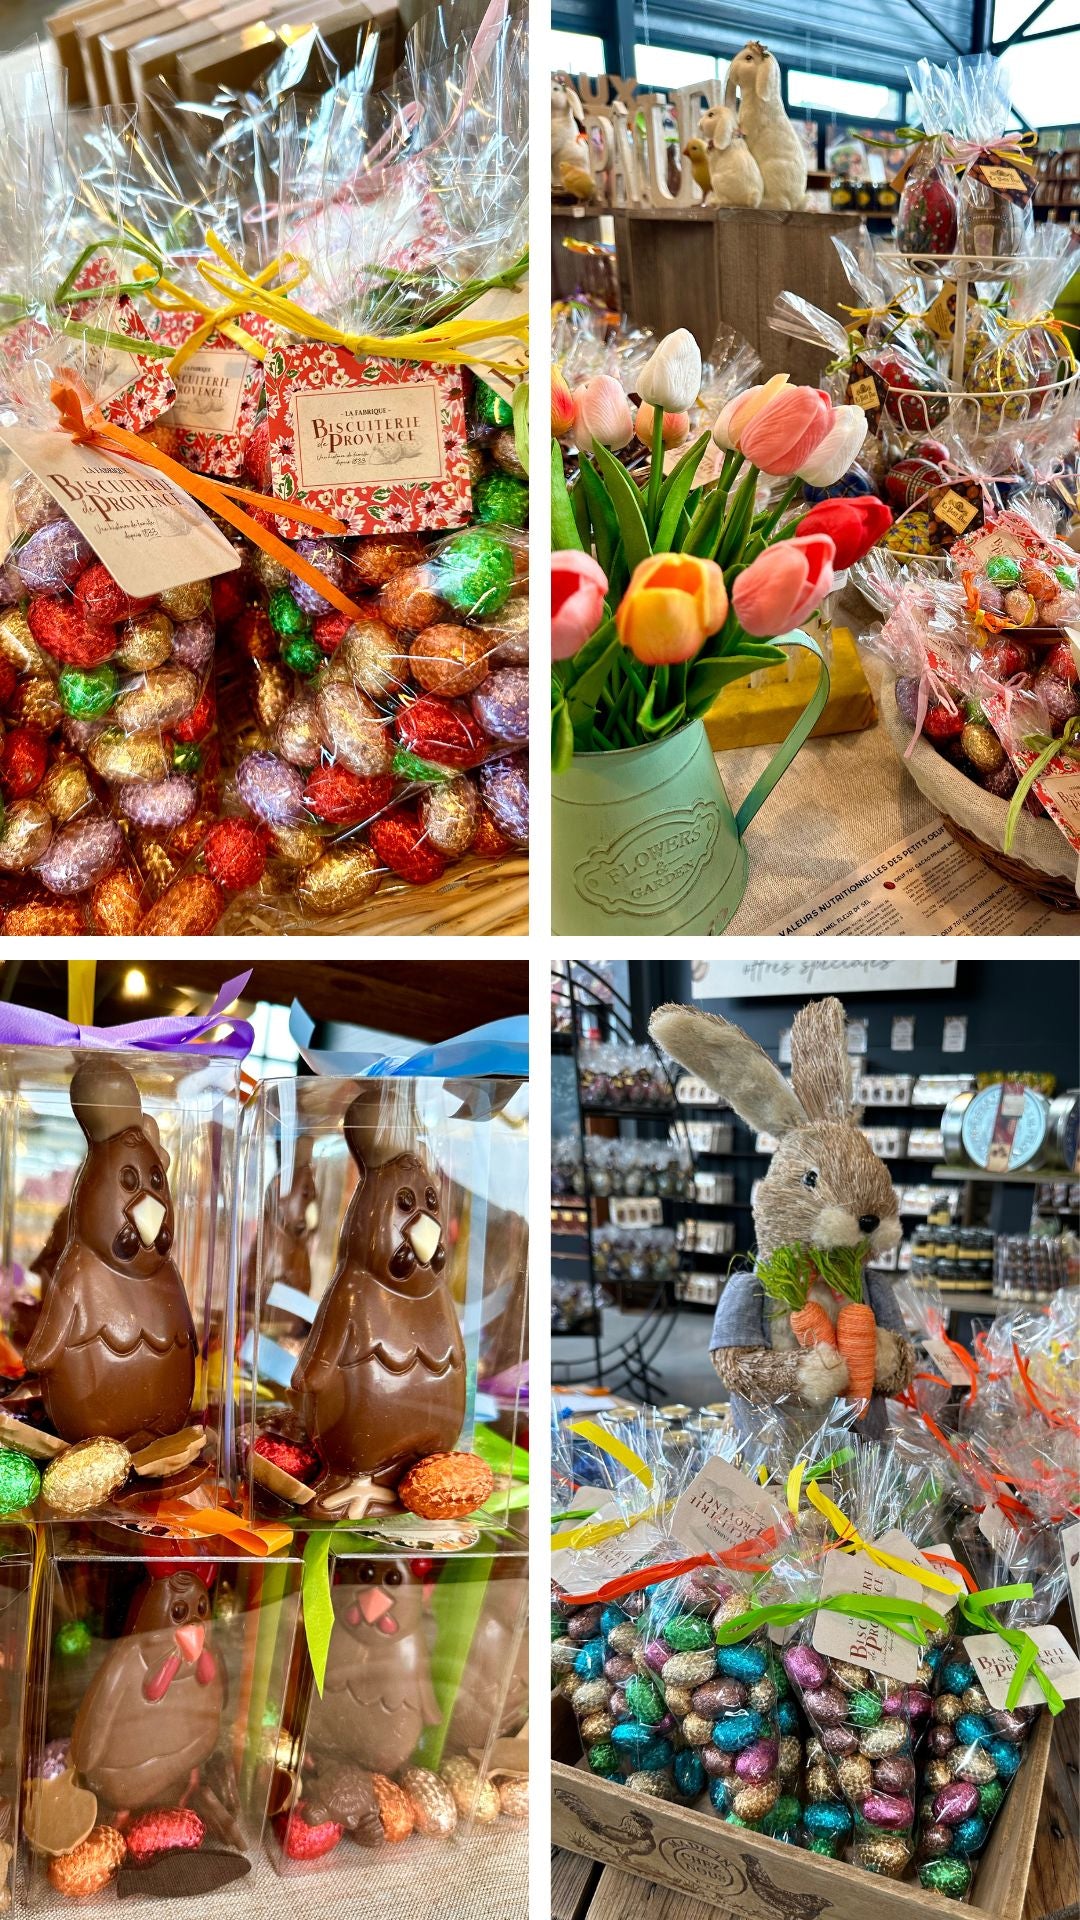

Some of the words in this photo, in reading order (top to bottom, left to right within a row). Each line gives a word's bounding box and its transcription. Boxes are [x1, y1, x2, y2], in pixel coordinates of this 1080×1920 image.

[176, 373, 229, 388] SCUITERIE
[177, 384, 223, 398] ROVENCE
[345, 409, 354, 417] LA
[355, 407, 387, 416] FABRIQUE
[311, 416, 421, 439] BISCUITERIE
[317, 437, 328, 449] de
[328, 429, 416, 453] PROVENCE
[47, 474, 174, 502] BISCUITERIE
[82, 499, 93, 514] de
[85, 493, 185, 522] PROVENCE
[606, 824, 701, 886] FLOWERS
[914, 856, 932, 869] CACAO
[630, 860, 695, 899] GARDEN
[655, 860, 669, 876] &
[778, 909, 819, 937] VALEURS
[818, 864, 888, 913] NUTRITIONNELLES
[887, 854, 904, 868] DES
[902, 838, 929, 858] PETITS
[813, 922, 838, 937] ARAMEL
[837, 909, 854, 925] FLEUR
[853, 905, 862, 915] DE
[860, 898, 872, 910] SEL
[940, 924, 954, 937] OEUF
[962, 905, 979, 922] CACAO
[668, 1839, 710, 1854] MADE
[714, 1854, 732, 1868] IN
[681, 1852, 720, 1871] CHEZ
[685, 1863, 727, 1883] NOUS
